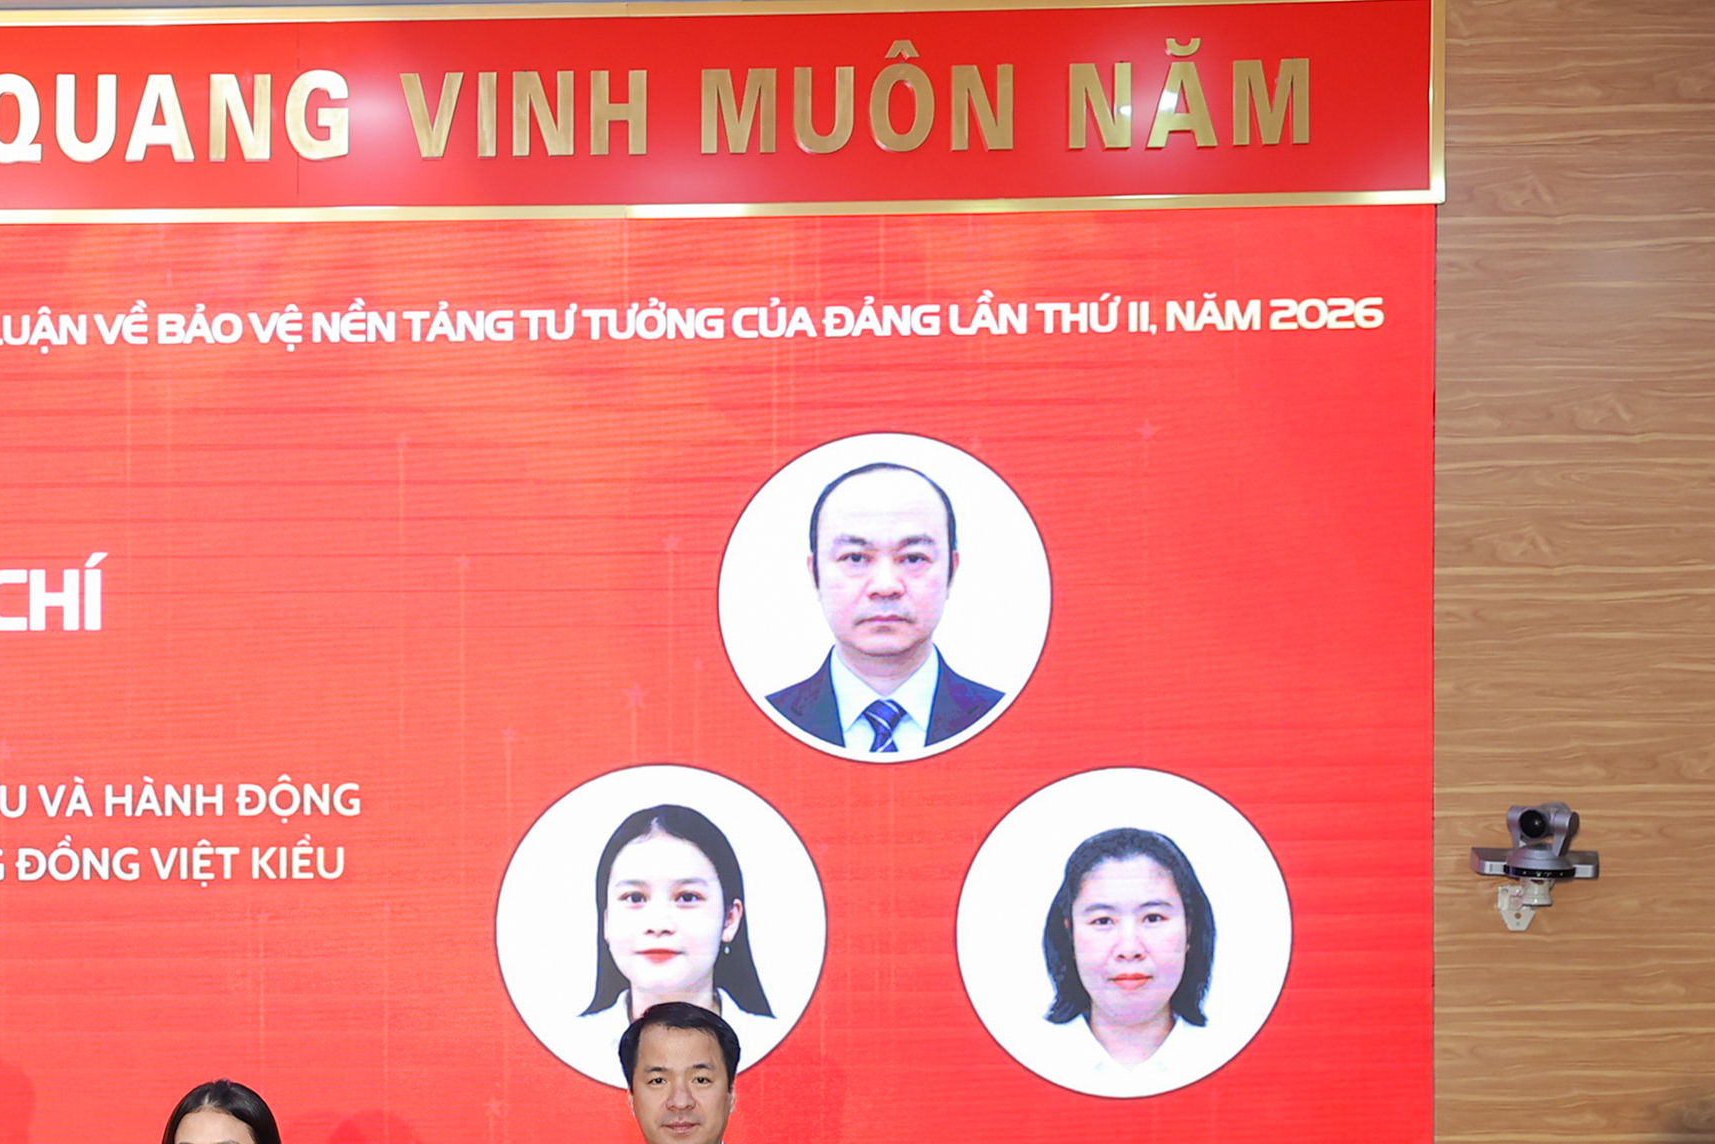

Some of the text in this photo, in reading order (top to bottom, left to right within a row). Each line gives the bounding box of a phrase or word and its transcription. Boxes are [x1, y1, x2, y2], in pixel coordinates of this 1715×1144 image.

[399, 69, 648, 160] VINH
[700, 40, 1014, 154] MUÔN
[1068, 37, 1310, 149] NĂM
[92, 299, 149, 345] VỀ
[156, 303, 244, 345] BẢO
[246, 303, 304, 353] VỆ
[311, 297, 396, 343] NỀN
[401, 300, 515, 343] TẢNG
[519, 302, 579, 341] TƯ
[581, 297, 725, 341] TƯỞNG
[731, 296, 818, 339] CỦA
[821, 295, 941, 338] ĐẢNG
[948, 289, 1028, 336] LẦN
[1034, 292, 1122, 334] THỨ
[1128, 300, 1158, 335] II,
[1166, 292, 1261, 332] NĂM
[1269, 297, 1384, 330] 2026
[37, 775, 94, 818] VÀ
[104, 775, 224, 817] HÀNH
[235, 773, 361, 824] ĐỘNG
[15, 834, 140, 881] ĐỒNG
[149, 838, 241, 888] VIỆT
[251, 833, 345, 880] KIỀU
